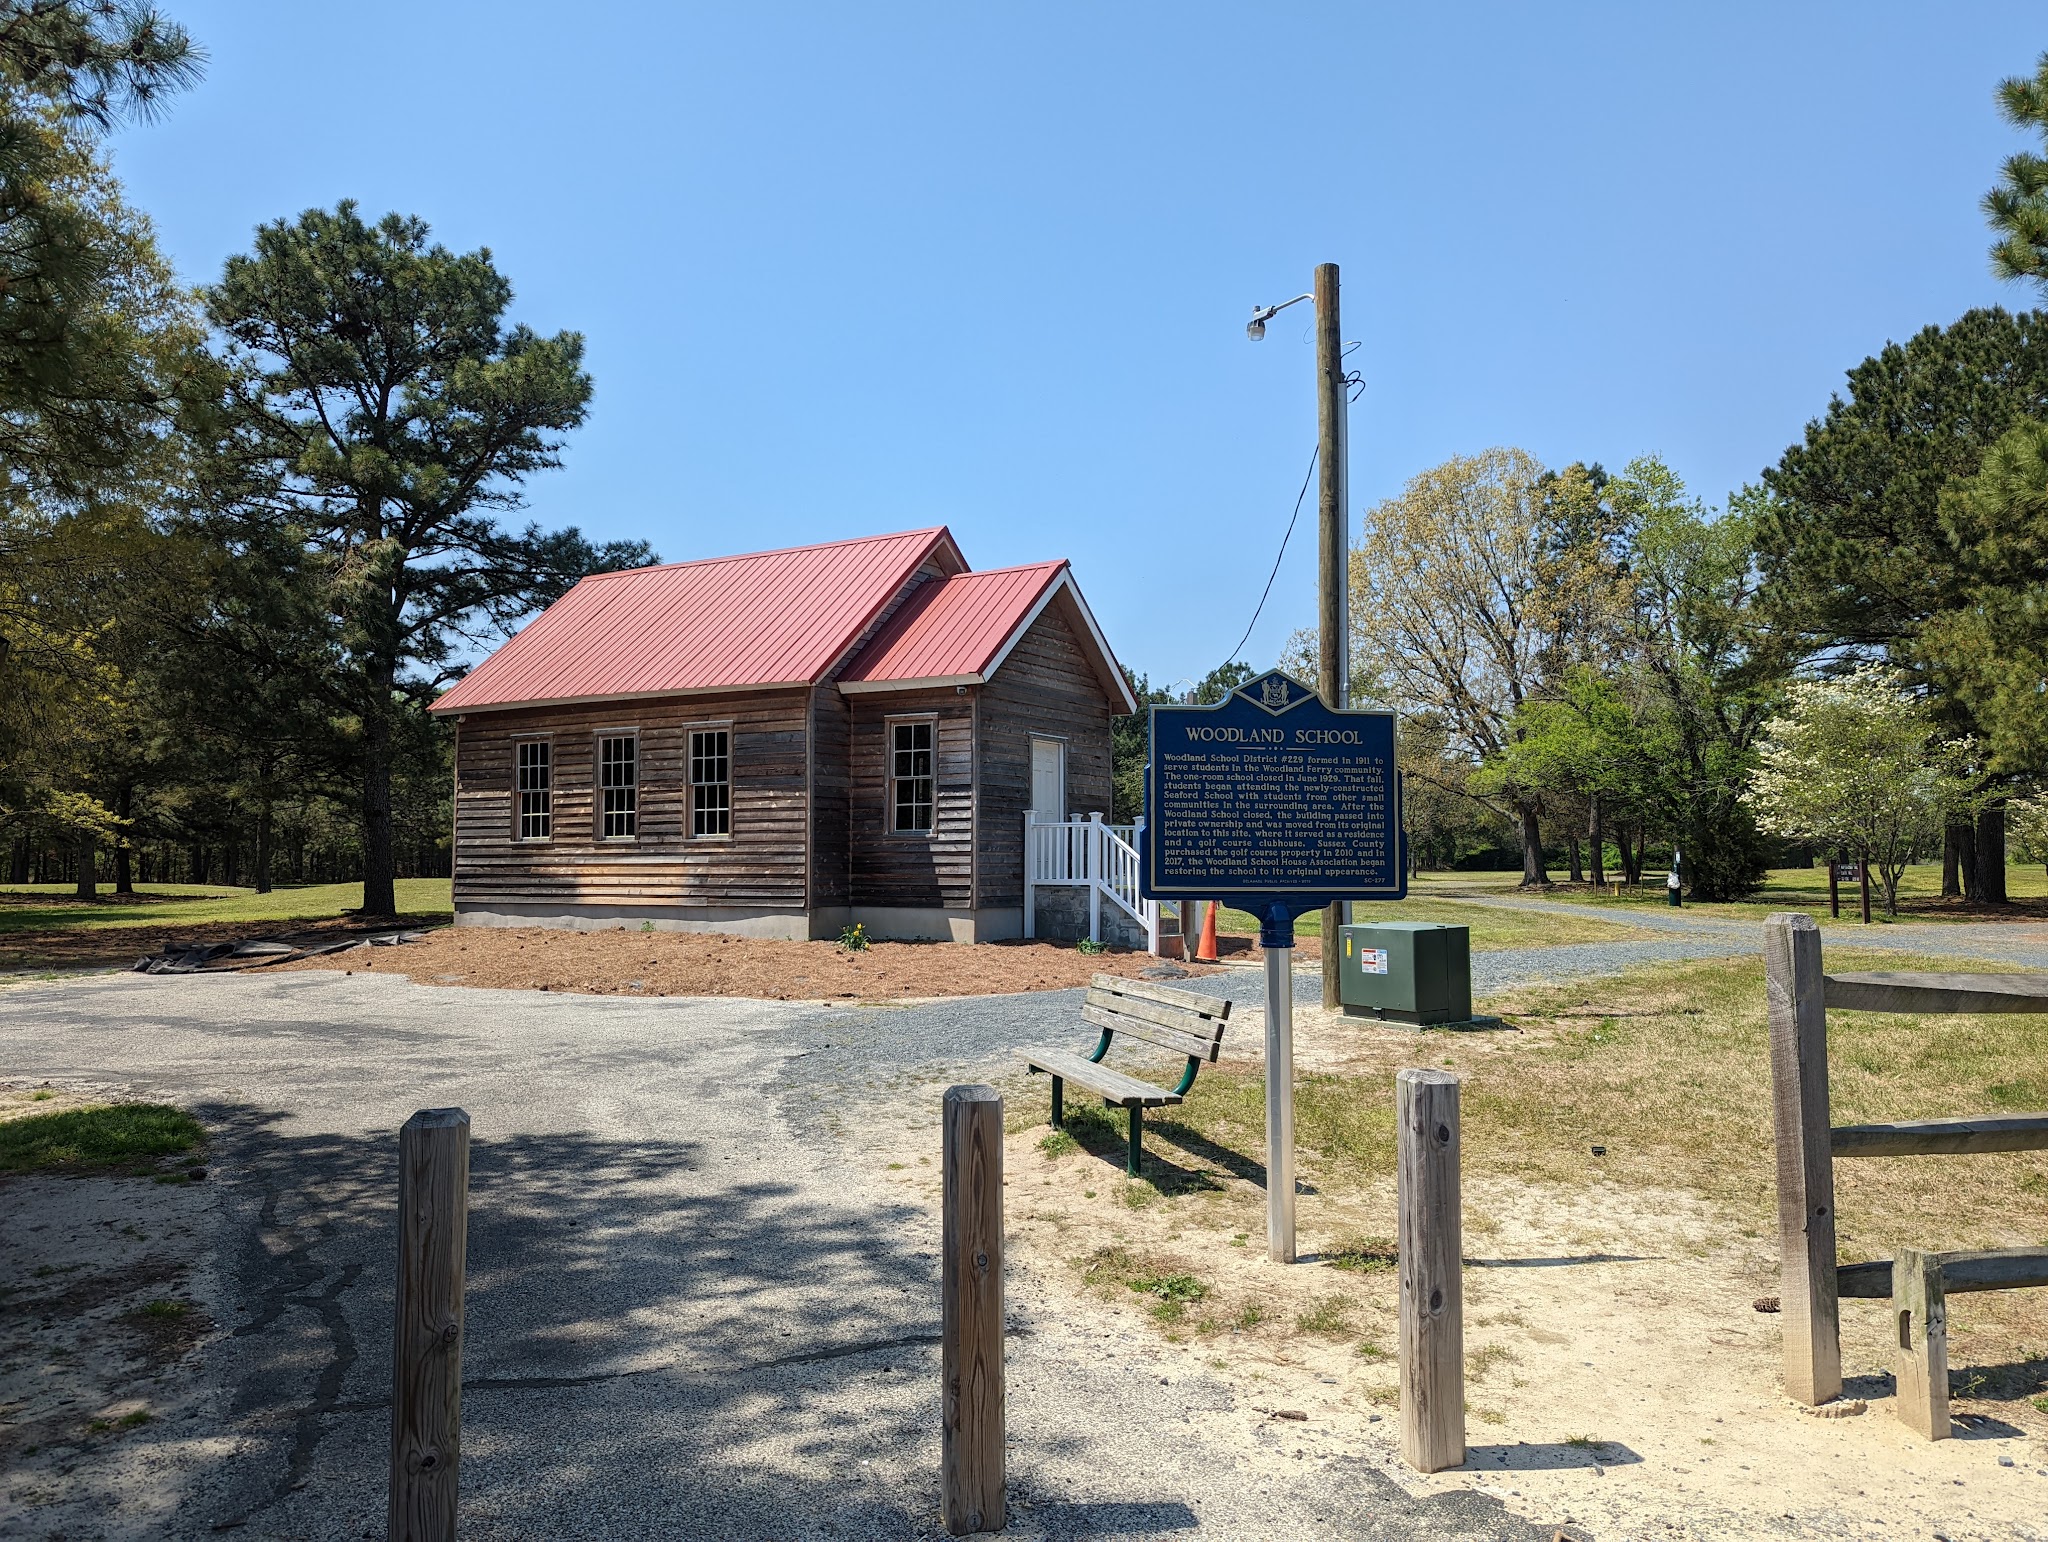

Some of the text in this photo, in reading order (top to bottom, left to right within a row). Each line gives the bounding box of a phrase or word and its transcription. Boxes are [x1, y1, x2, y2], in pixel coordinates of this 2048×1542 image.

[1186, 728, 1363, 744] WOODLAND SCHOOL
[1307, 766, 1332, 774] Ferry
[1334, 766, 1384, 774] community.
[1205, 783, 1232, 791] began
[1237, 783, 1280, 791] attending
[1304, 784, 1384, 793] newly-constructed
[1296, 812, 1331, 820] building
[1334, 812, 1363, 820] passed
[1164, 820, 1196, 828] private
[1198, 820, 1244, 829] ownership
[1351, 822, 1384, 830] original
[1198, 839, 1216, 848] golf
[1352, 840, 1385, 848] County
[1164, 849, 1210, 857] purchased
[1230, 849, 1248, 857] golf
[1281, 849, 1321, 857] property
[1360, 859, 1385, 867] began
[1165, 868, 1207, 876] restoring
[1287, 868, 1322, 876] original
